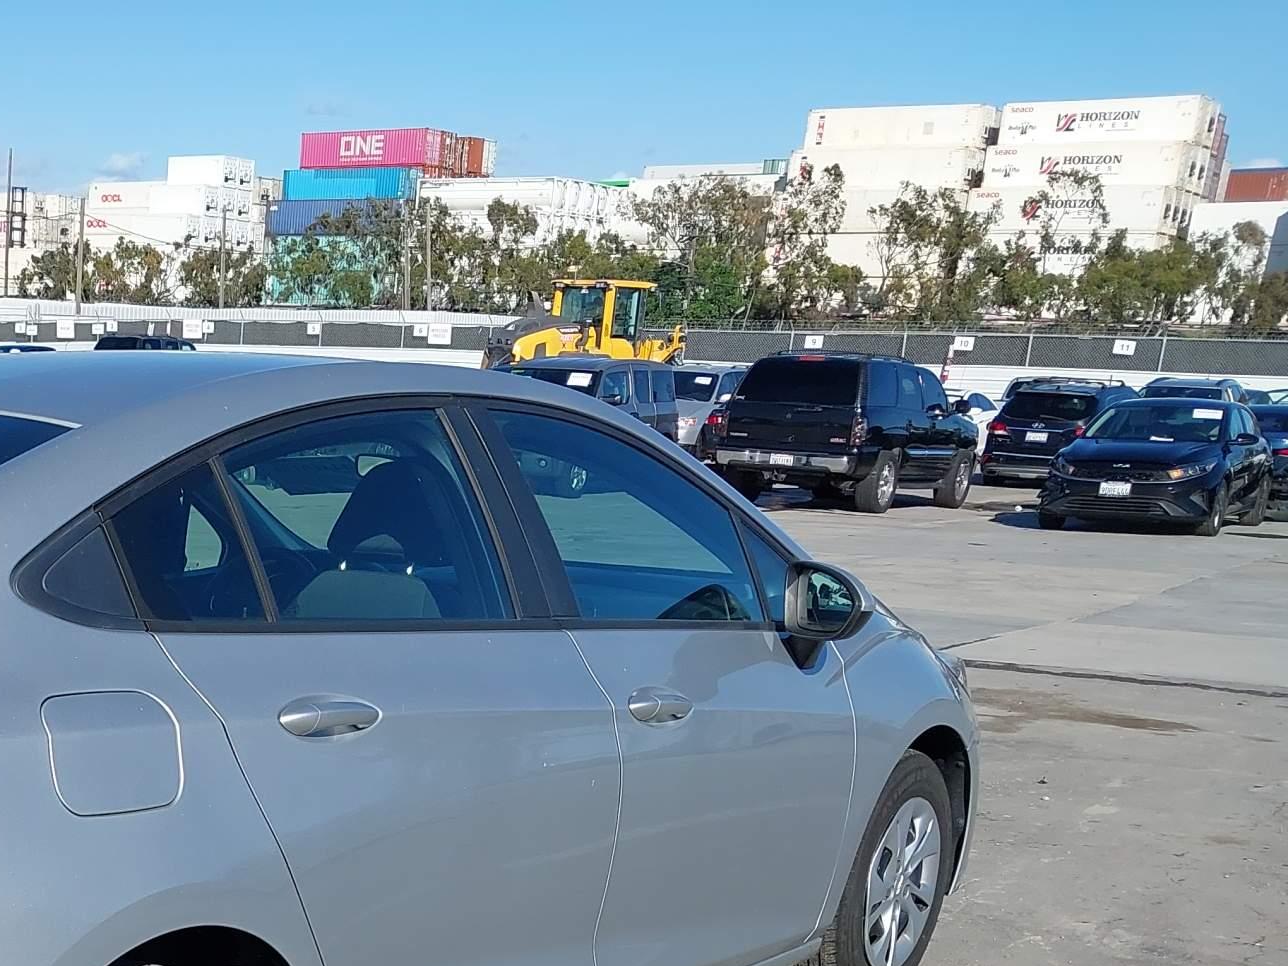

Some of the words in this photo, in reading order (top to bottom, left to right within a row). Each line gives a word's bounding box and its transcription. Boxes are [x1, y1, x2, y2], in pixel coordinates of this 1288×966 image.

[1079, 110, 1141, 121] HORIZON
[340, 134, 385, 156] ONE
[1063, 154, 1123, 165] HORIZON
[1045, 199, 1104, 209] HORIZON
[812, 338, 817, 346] 9
[958, 339, 969, 348] 10
[1121, 343, 1129, 352] 11
